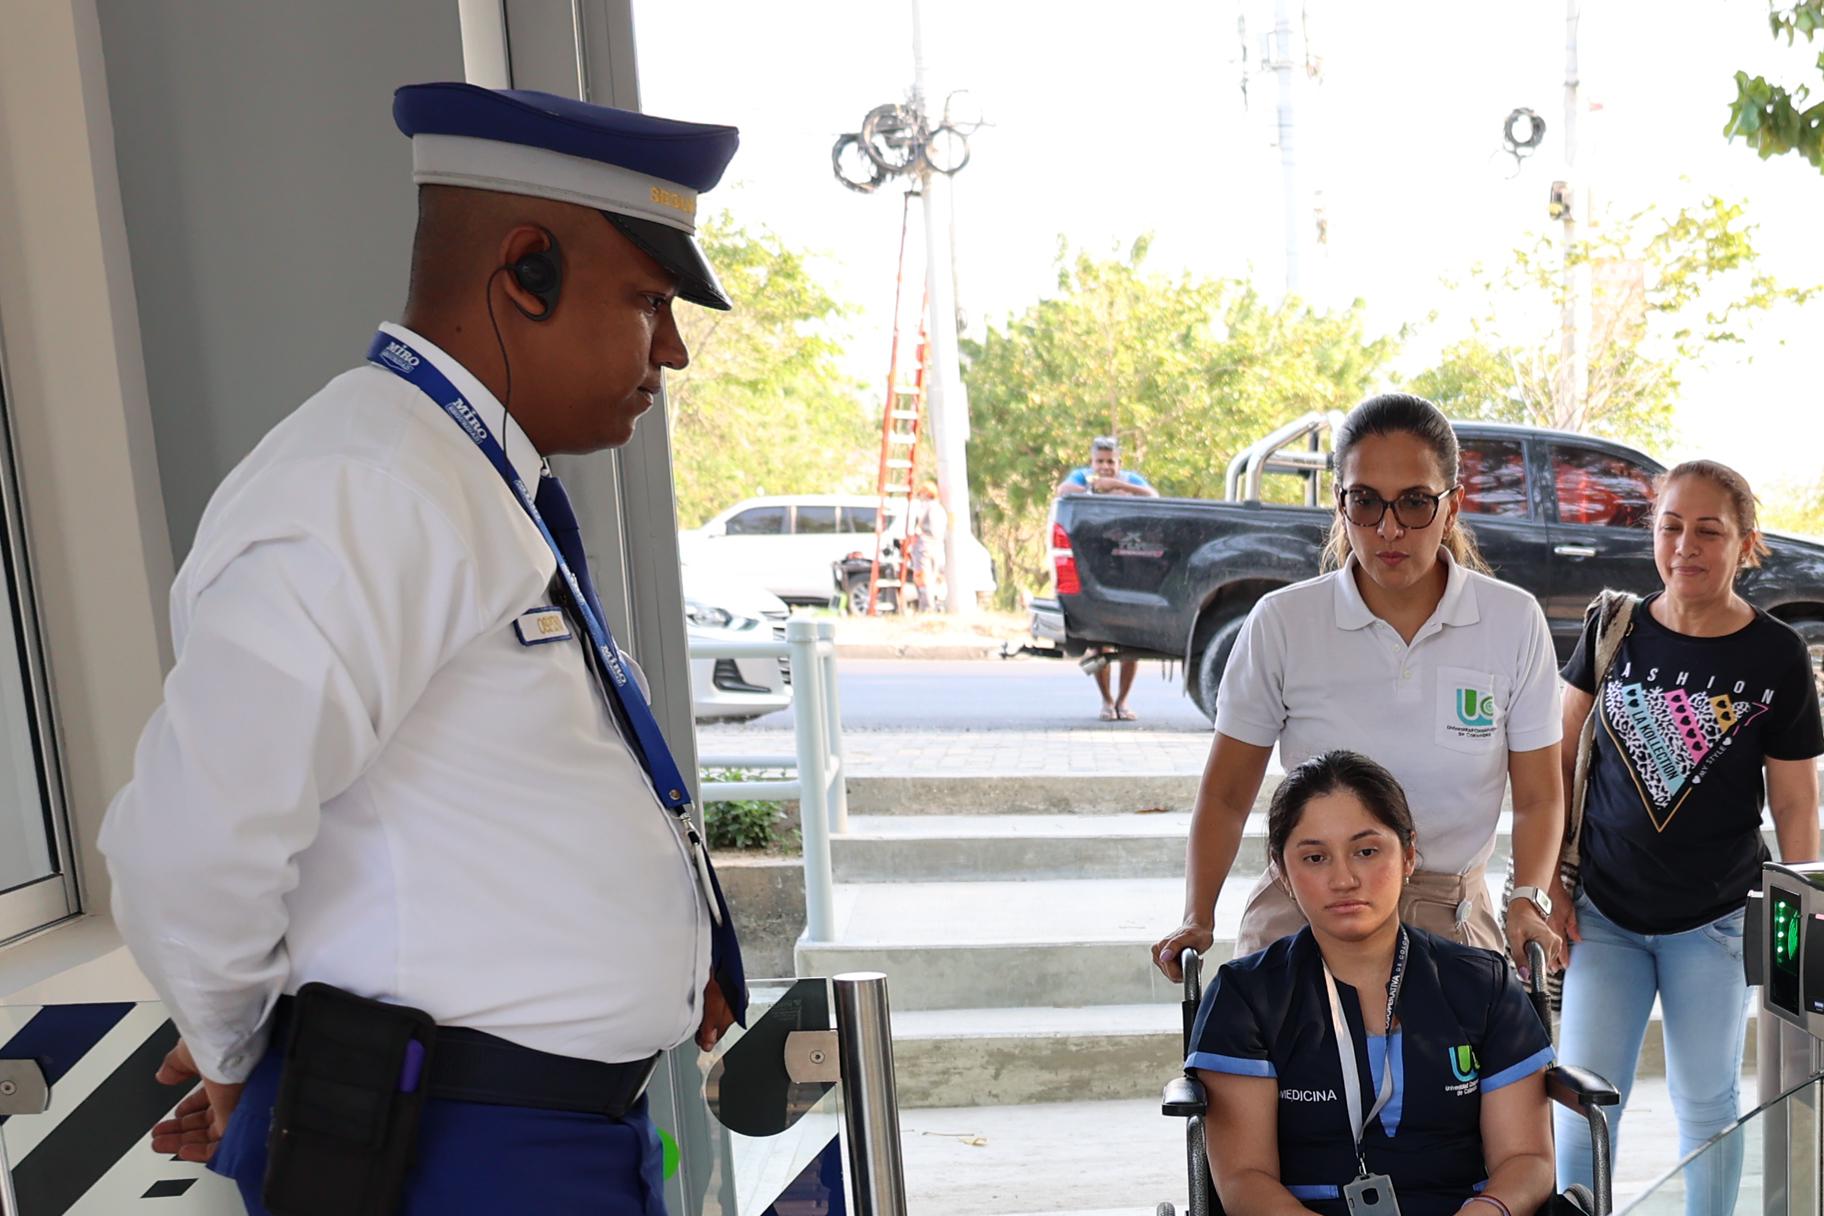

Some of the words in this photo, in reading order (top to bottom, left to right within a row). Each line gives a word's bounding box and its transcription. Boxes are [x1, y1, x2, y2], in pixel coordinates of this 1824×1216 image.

[453, 397, 487, 440] MIRO
[1632, 710, 1647, 725] LA
[1639, 724, 1679, 780] KOLLECTION
[1280, 1089, 1337, 1102] MEDICINA
